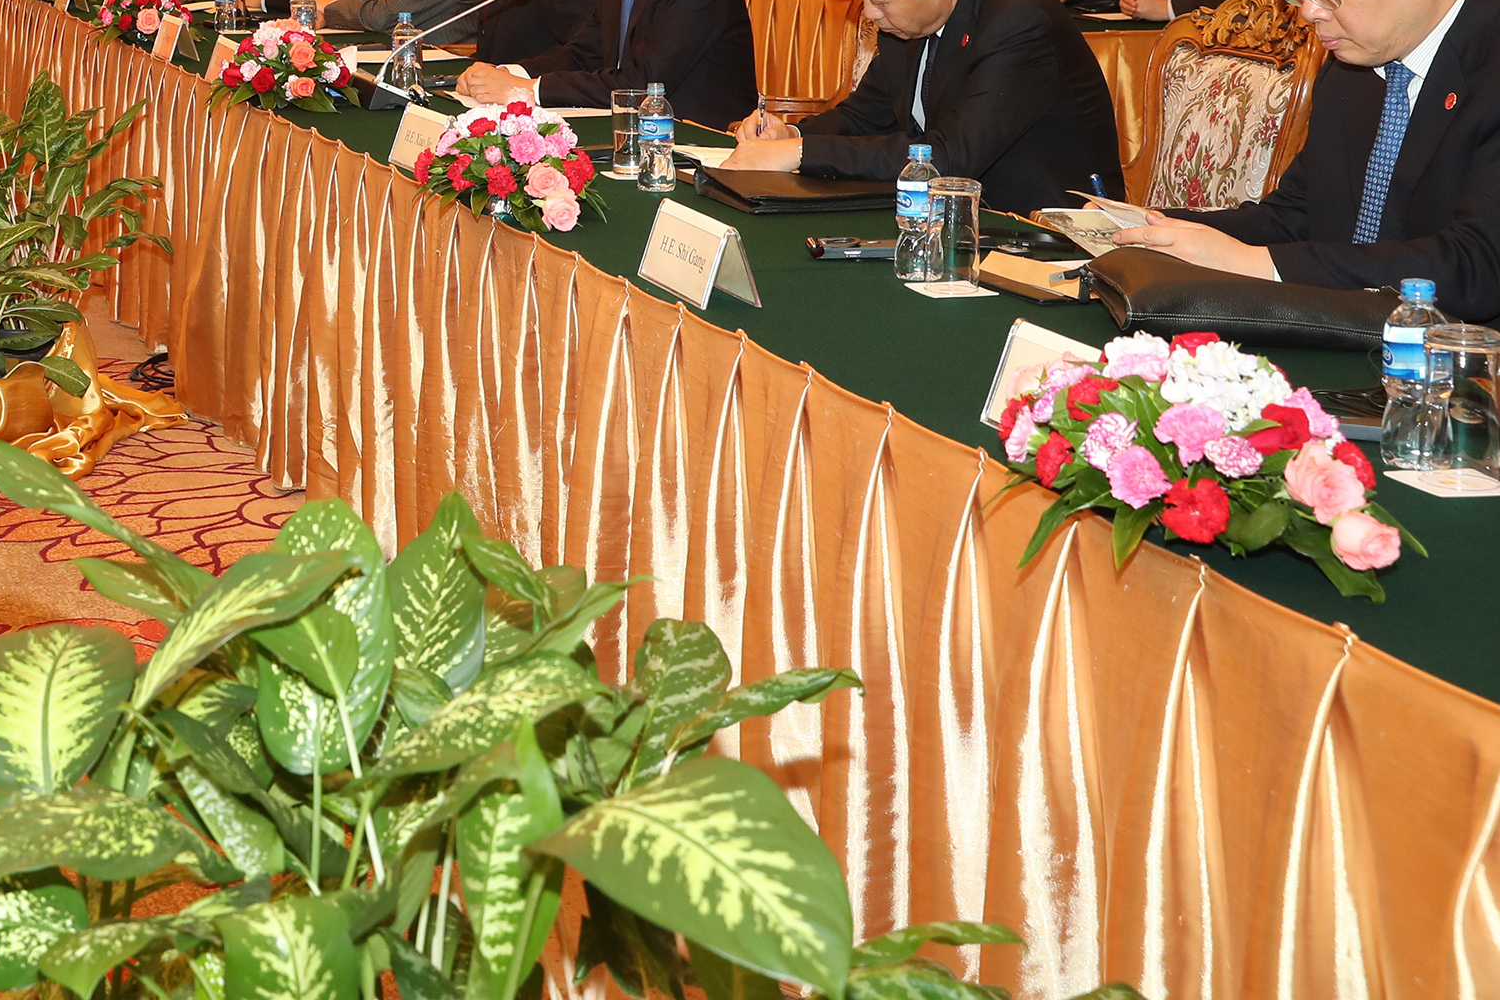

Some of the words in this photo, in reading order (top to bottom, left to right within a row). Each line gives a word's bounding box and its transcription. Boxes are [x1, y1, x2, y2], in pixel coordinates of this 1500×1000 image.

[660, 235, 676, 256] H.E.
[676, 242, 691, 262] Shi
[688, 248, 706, 274] Gang
